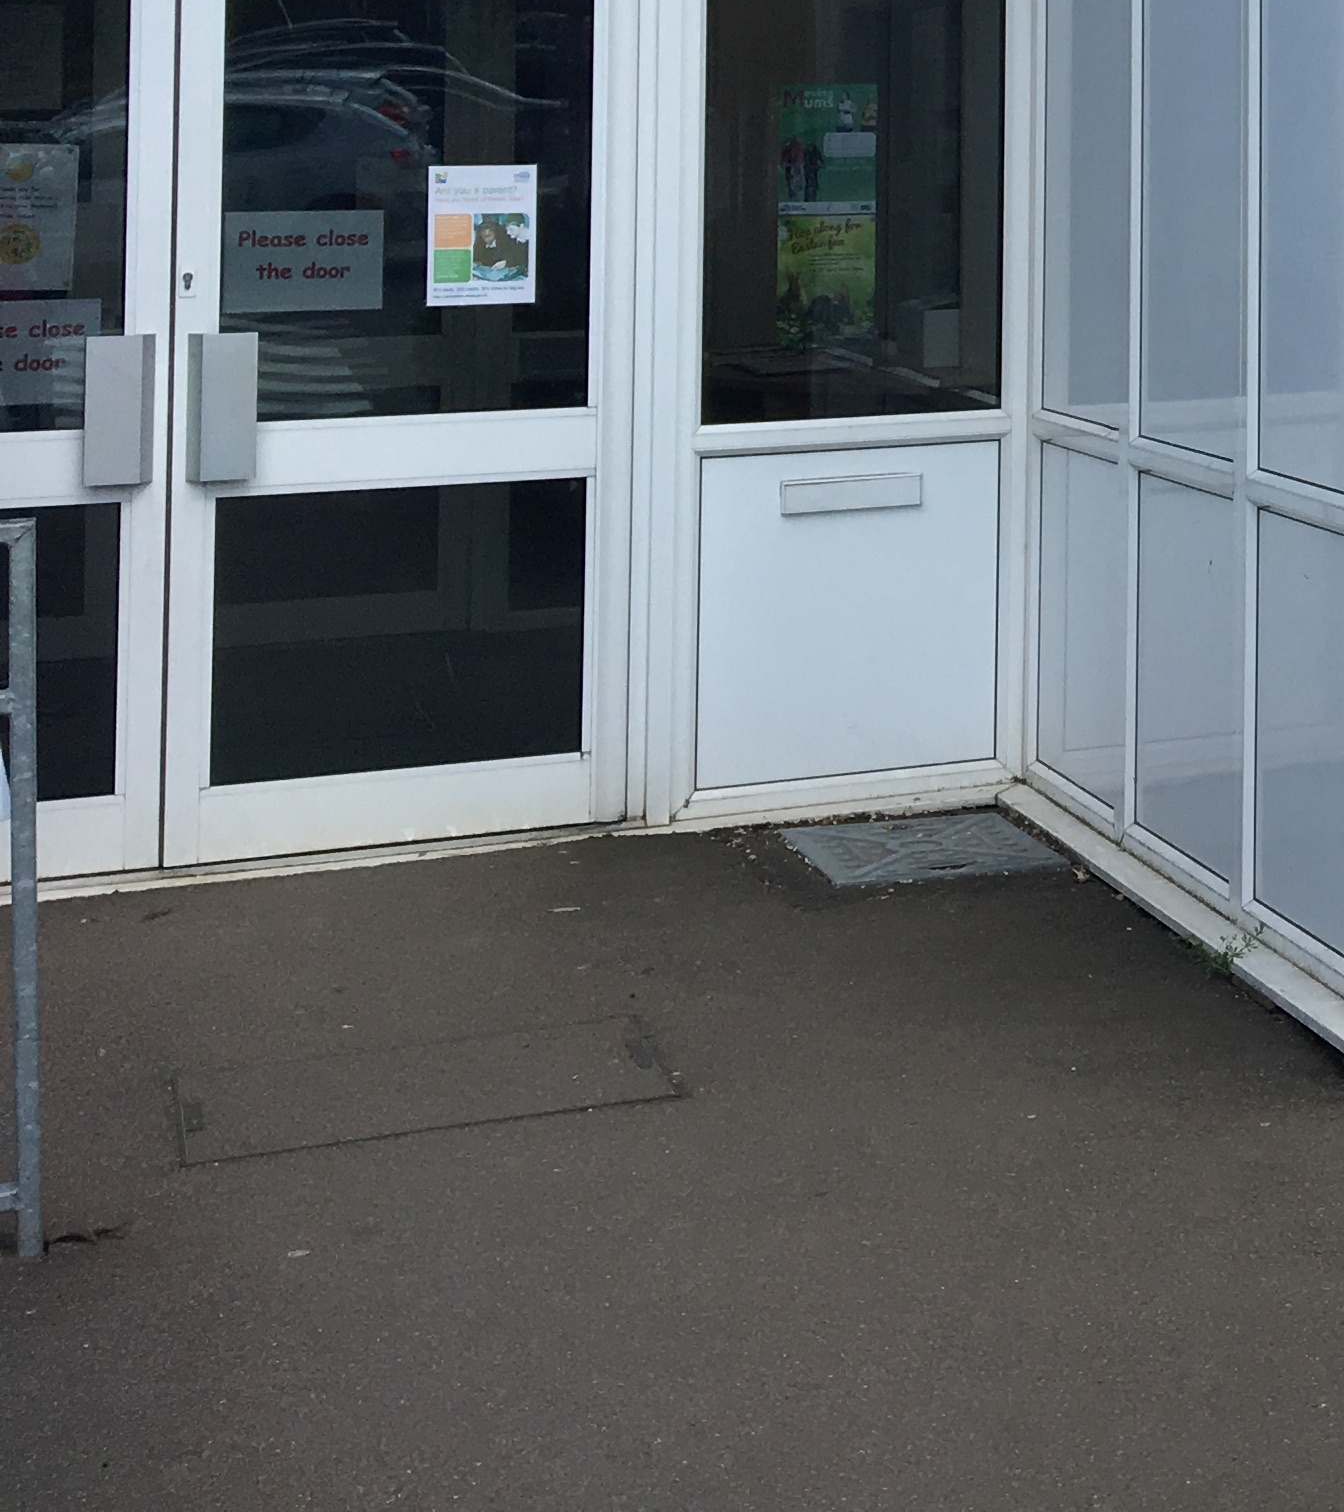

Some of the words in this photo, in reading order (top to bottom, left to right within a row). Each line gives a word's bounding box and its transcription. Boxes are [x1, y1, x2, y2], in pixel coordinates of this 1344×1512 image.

[238, 229, 306, 247] Please
[316, 229, 369, 247] close
[256, 262, 292, 280] the
[302, 262, 351, 279] door
[28, 319, 85, 338] close
[14, 353, 65, 372] door
